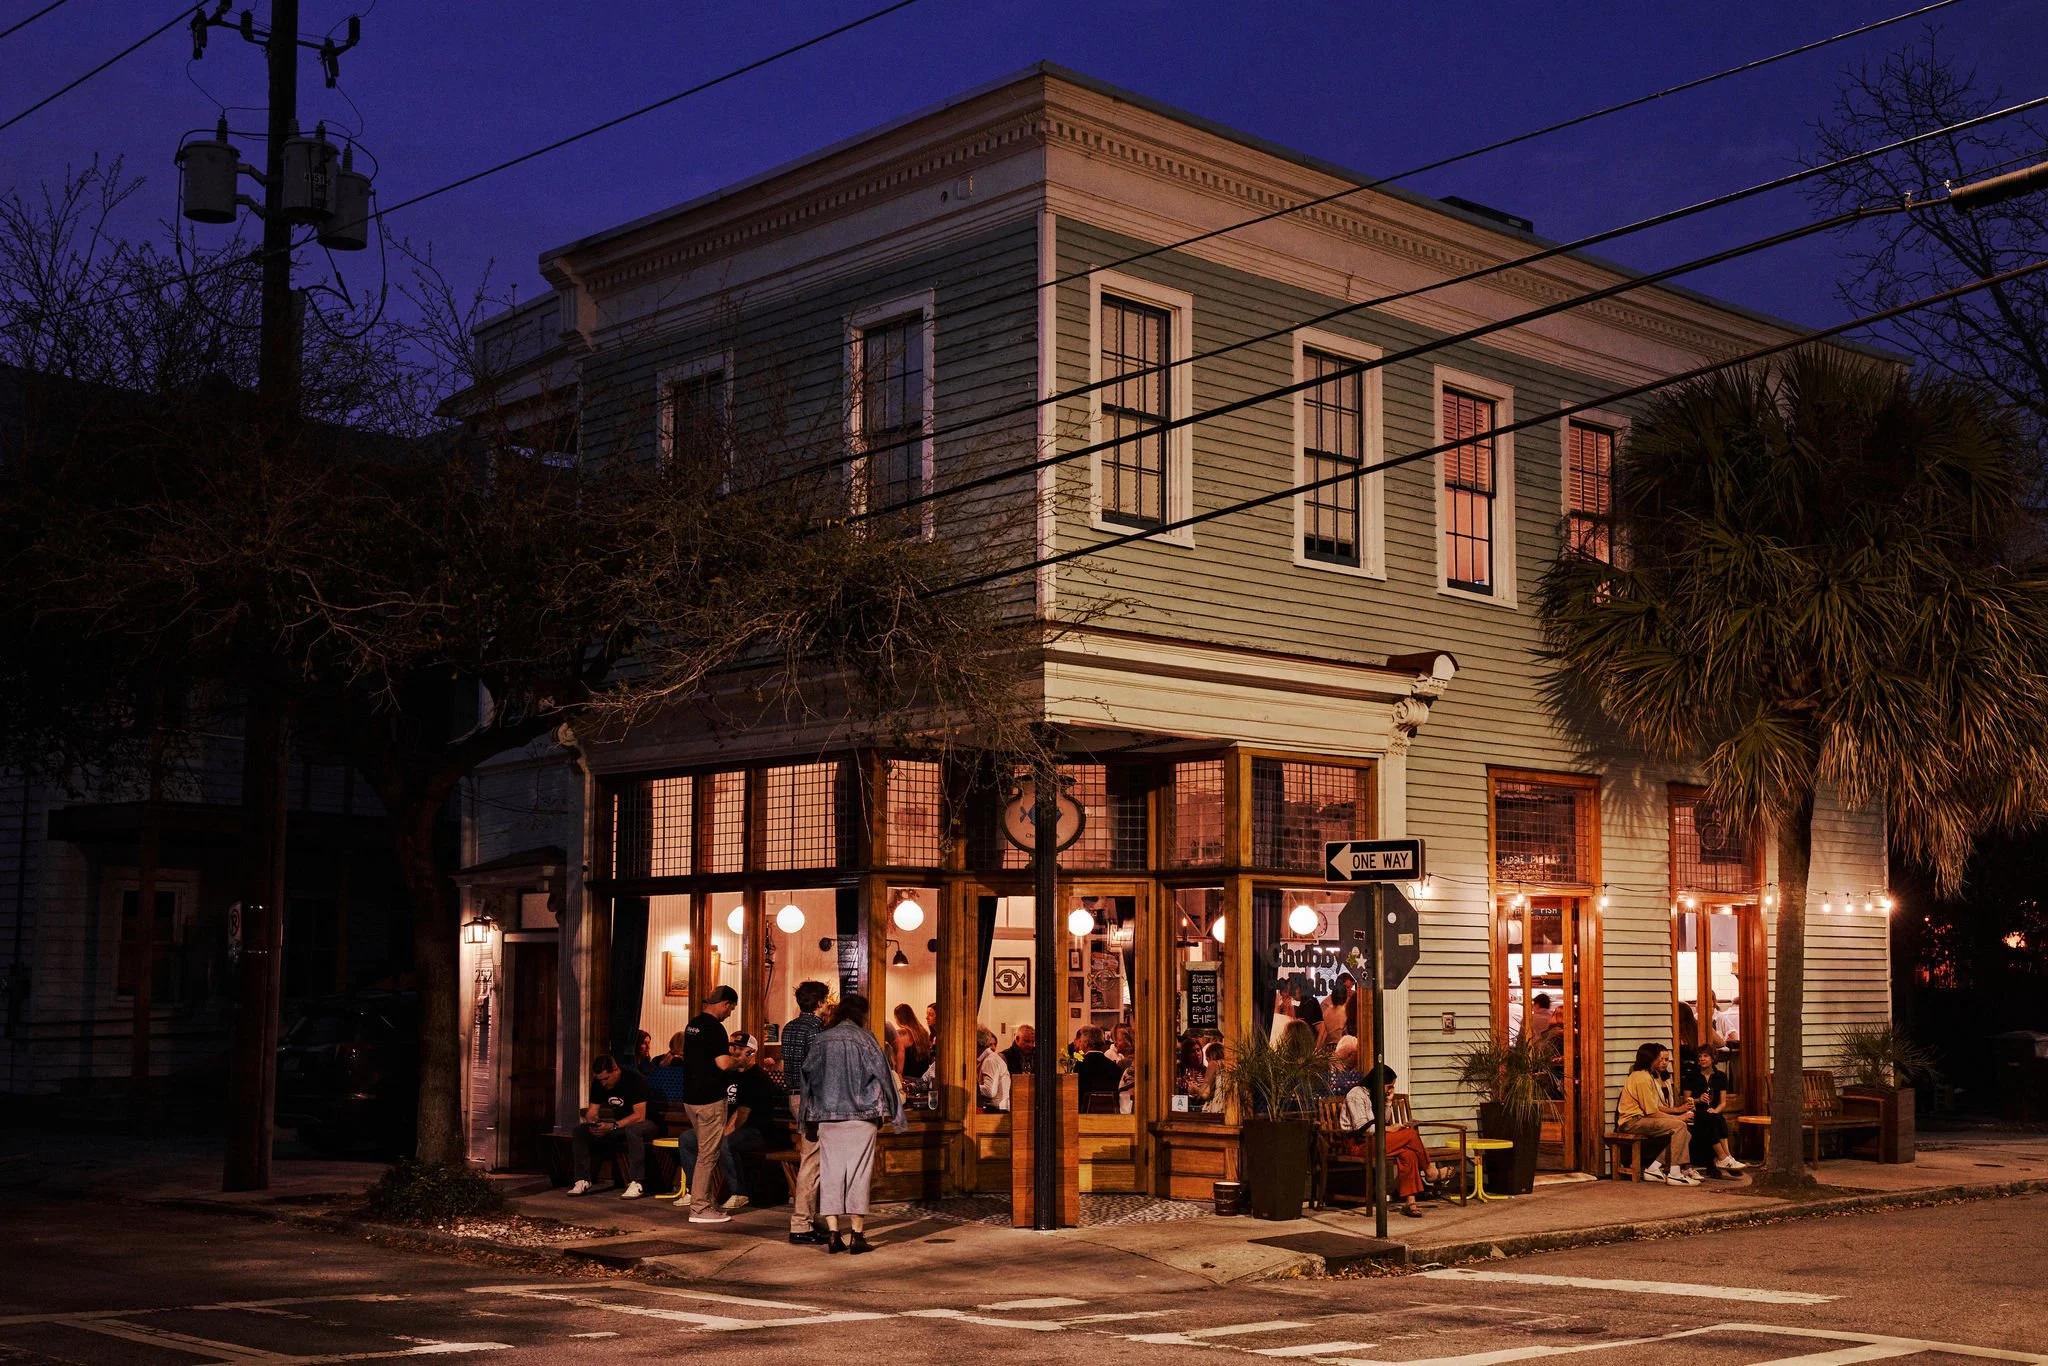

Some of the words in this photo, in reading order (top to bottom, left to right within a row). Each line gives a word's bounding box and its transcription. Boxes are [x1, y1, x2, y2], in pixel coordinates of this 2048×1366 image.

[1352, 854, 1377, 870] ONE
[1382, 852, 1409, 869] WAY
[1267, 943, 1341, 975] Chubby
